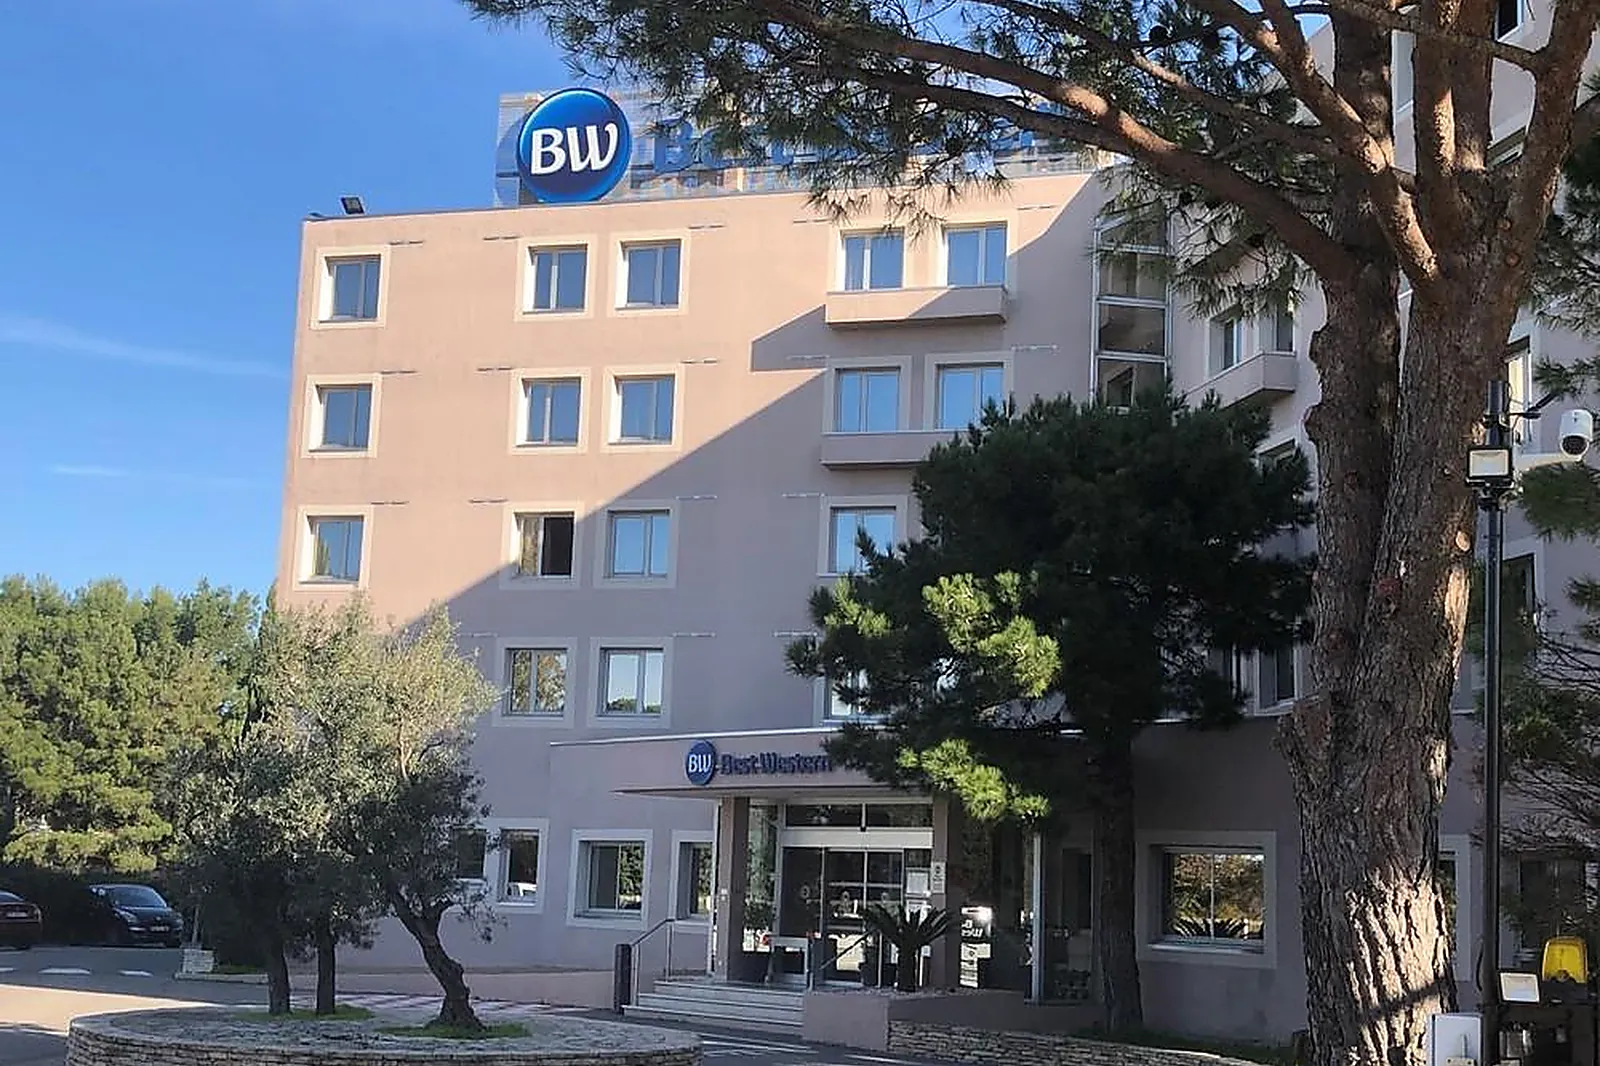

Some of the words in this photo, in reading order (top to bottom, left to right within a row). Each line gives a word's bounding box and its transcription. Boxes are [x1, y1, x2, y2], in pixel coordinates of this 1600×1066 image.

[531, 122, 618, 175] BW
[688, 754, 712, 773] BW
[720, 753, 759, 775] Best
[760, 752, 833, 774] Western
